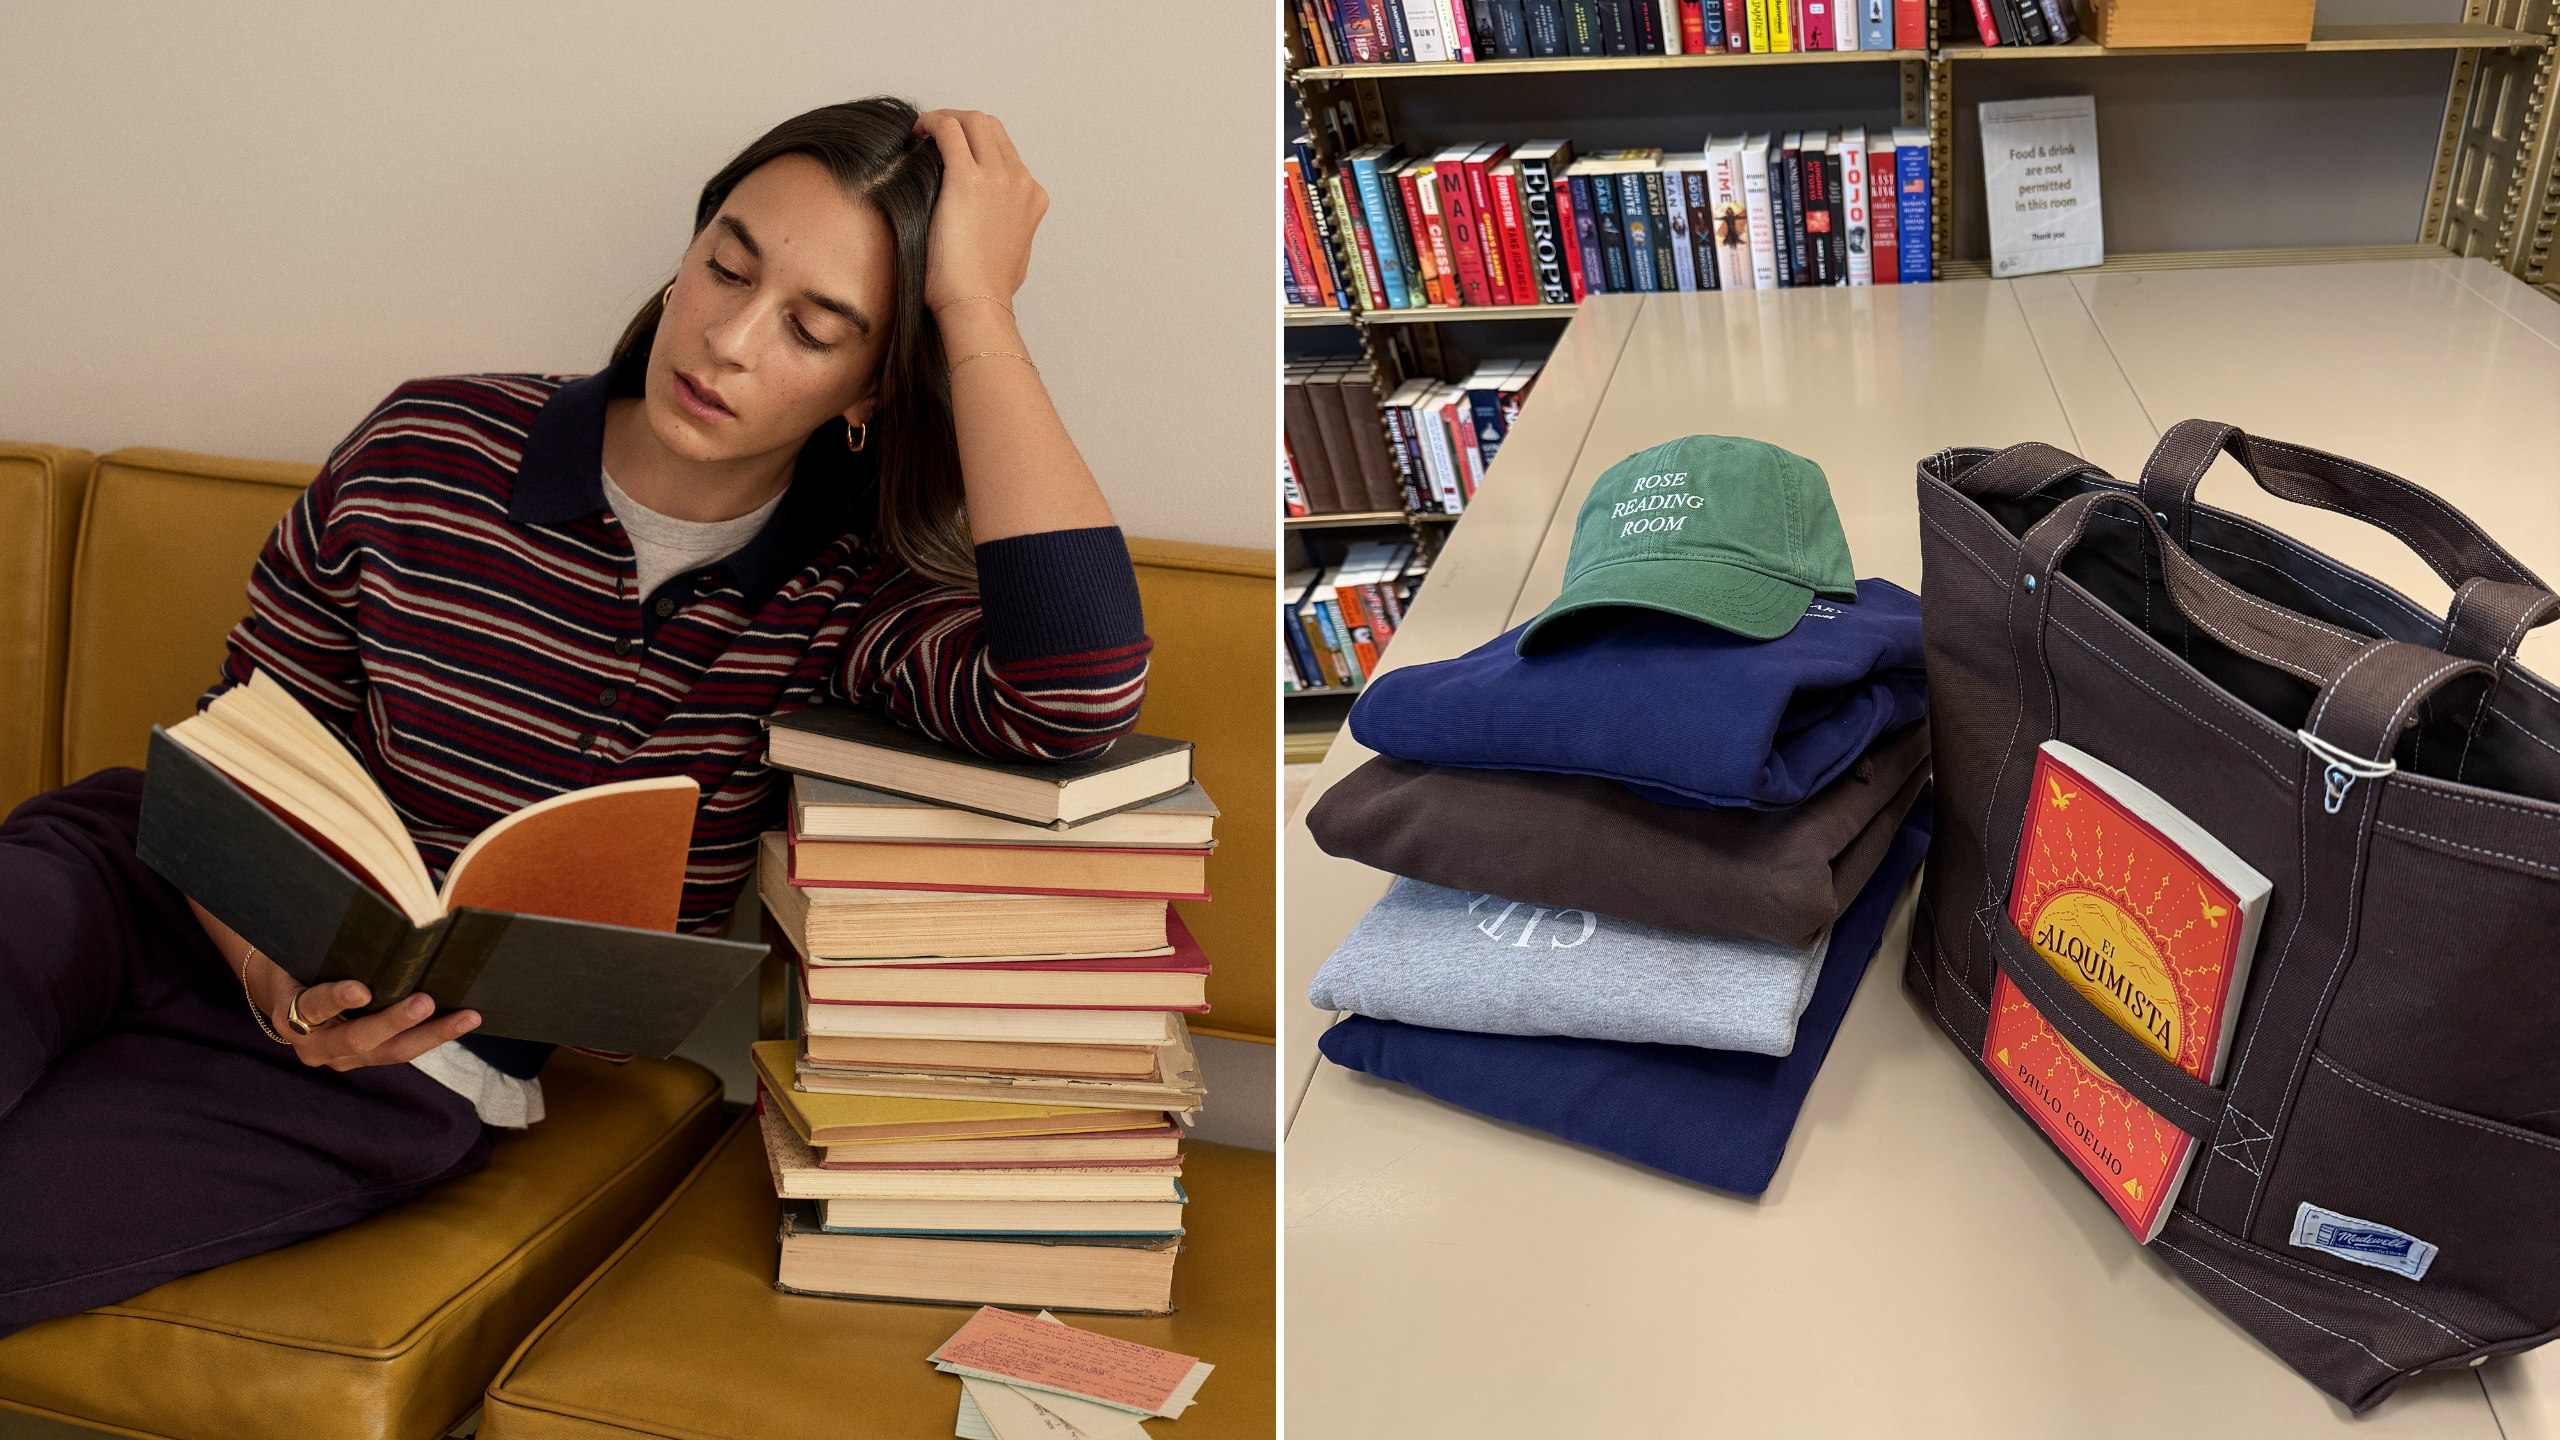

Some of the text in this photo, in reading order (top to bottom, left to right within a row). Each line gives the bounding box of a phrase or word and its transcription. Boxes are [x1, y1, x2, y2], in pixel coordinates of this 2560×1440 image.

[1343, 0, 1365, 31] INGS
[1371, 4, 1389, 46] SANDERSON
[1391, 5, 1405, 43] DAWNSHARD
[1413, 28, 1436, 37] SUNY
[2009, 144, 2076, 160] Food & drink
[1340, 167, 1349, 177] THE
[1716, 159, 1732, 203] TIME
[1788, 157, 1802, 214] SOMEWHERE
[1813, 161, 1824, 200] JUDGMENT
[1847, 150, 1863, 222] TOJO
[2025, 163, 2063, 177] are not
[1360, 169, 1383, 222] ALEXANDER
[1594, 177, 1609, 214] DARK
[1621, 174, 1636, 216] WHITE
[1630, 174, 1640, 204] DEMON
[1645, 174, 1660, 216] DEATH
[1665, 175, 1678, 207] MAN
[1687, 175, 1700, 209] GODS
[1808, 174, 1817, 201] TOKYO
[1871, 186, 1895, 197] KING
[2018, 178, 2072, 198] permitted
[1307, 183, 1329, 237] ARISTOTLE
[1442, 173, 1469, 243] MAO
[1496, 176, 1517, 228] TOMBSTONE
[1508, 228, 1520, 250] YANG
[2015, 198, 2077, 212] in this room
[1520, 160, 1566, 303] EUROPE
[1773, 200, 1789, 281] THE COMING STORM
[1795, 226, 1805, 244] THE
[2032, 232, 2066, 241] Thank you
[1428, 224, 1450, 275] CHESS
[1482, 212, 1505, 287] CHINA'S LEADERS
[1796, 245, 1807, 267] DEEP
[1394, 443, 1412, 475] BERLIN
[1633, 472, 1688, 494] ROSE
[1611, 493, 1704, 519] READING
[1620, 516, 1688, 538] ROOM
[1810, 601, 1848, 615] ARY
[2036, 923, 2173, 1056] ALQUIMISTA
[2018, 1064, 2123, 1176] PAULO COELHO
[2337, 1230, 2406, 1248] Madewell
